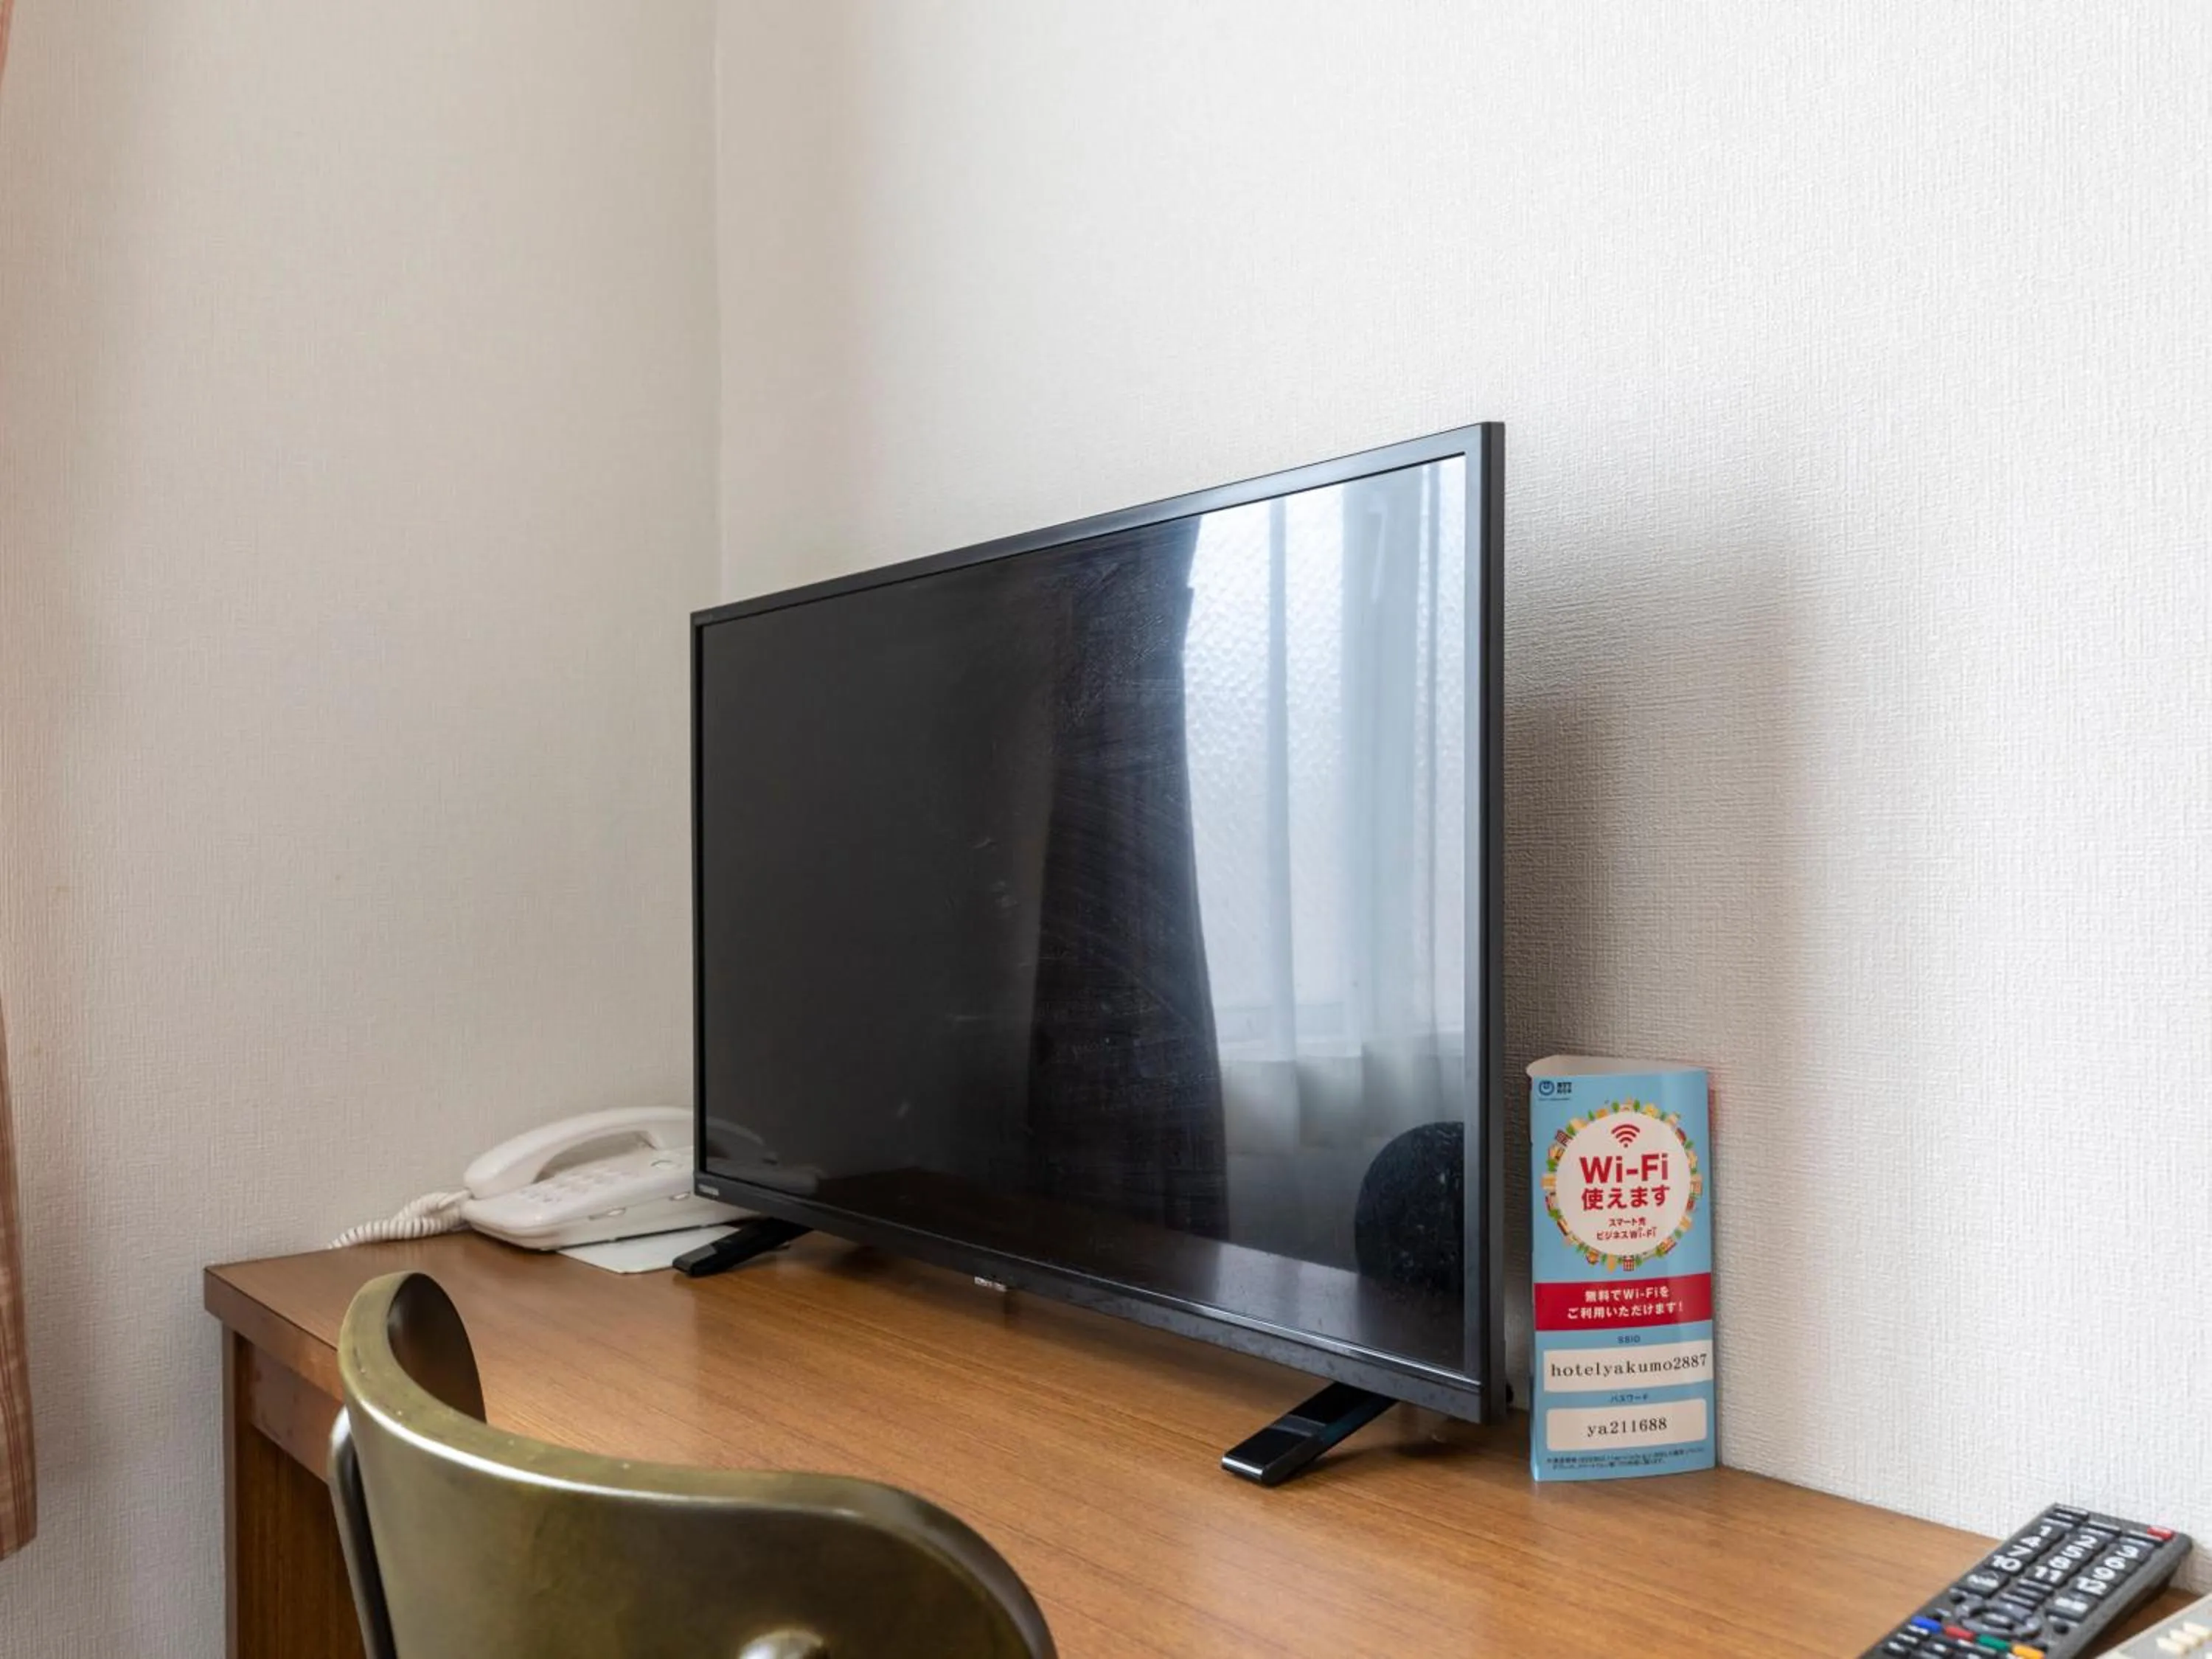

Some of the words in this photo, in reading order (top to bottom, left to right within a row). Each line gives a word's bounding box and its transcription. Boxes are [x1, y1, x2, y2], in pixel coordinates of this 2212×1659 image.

[1579, 1153, 1669, 1184] Wi-Fi
[1581, 1185, 1670, 1211] 使えます
[1585, 1286, 1669, 1303] 無料でWi-Fiを
[1618, 1335, 1641, 1343] SSID
[1551, 1354, 1708, 1377] hotelyakumo2887
[1587, 1417, 1668, 1437] ya211688
[2039, 1525, 2053, 1537] 1
[2020, 1536, 2042, 1548] 4
[2073, 1534, 2098, 1549] 2
[2006, 1545, 2033, 1557] 7
[2062, 1545, 2084, 1559] 5
[2115, 1545, 2140, 1559] 3
[1992, 1554, 2022, 1571] 10
[2048, 1555, 2072, 1570] 8
[2104, 1557, 2126, 1570] 6
[2034, 1565, 2063, 1582] 11
[2093, 1566, 2115, 1581] 9
[2076, 1576, 2107, 1595] 12
